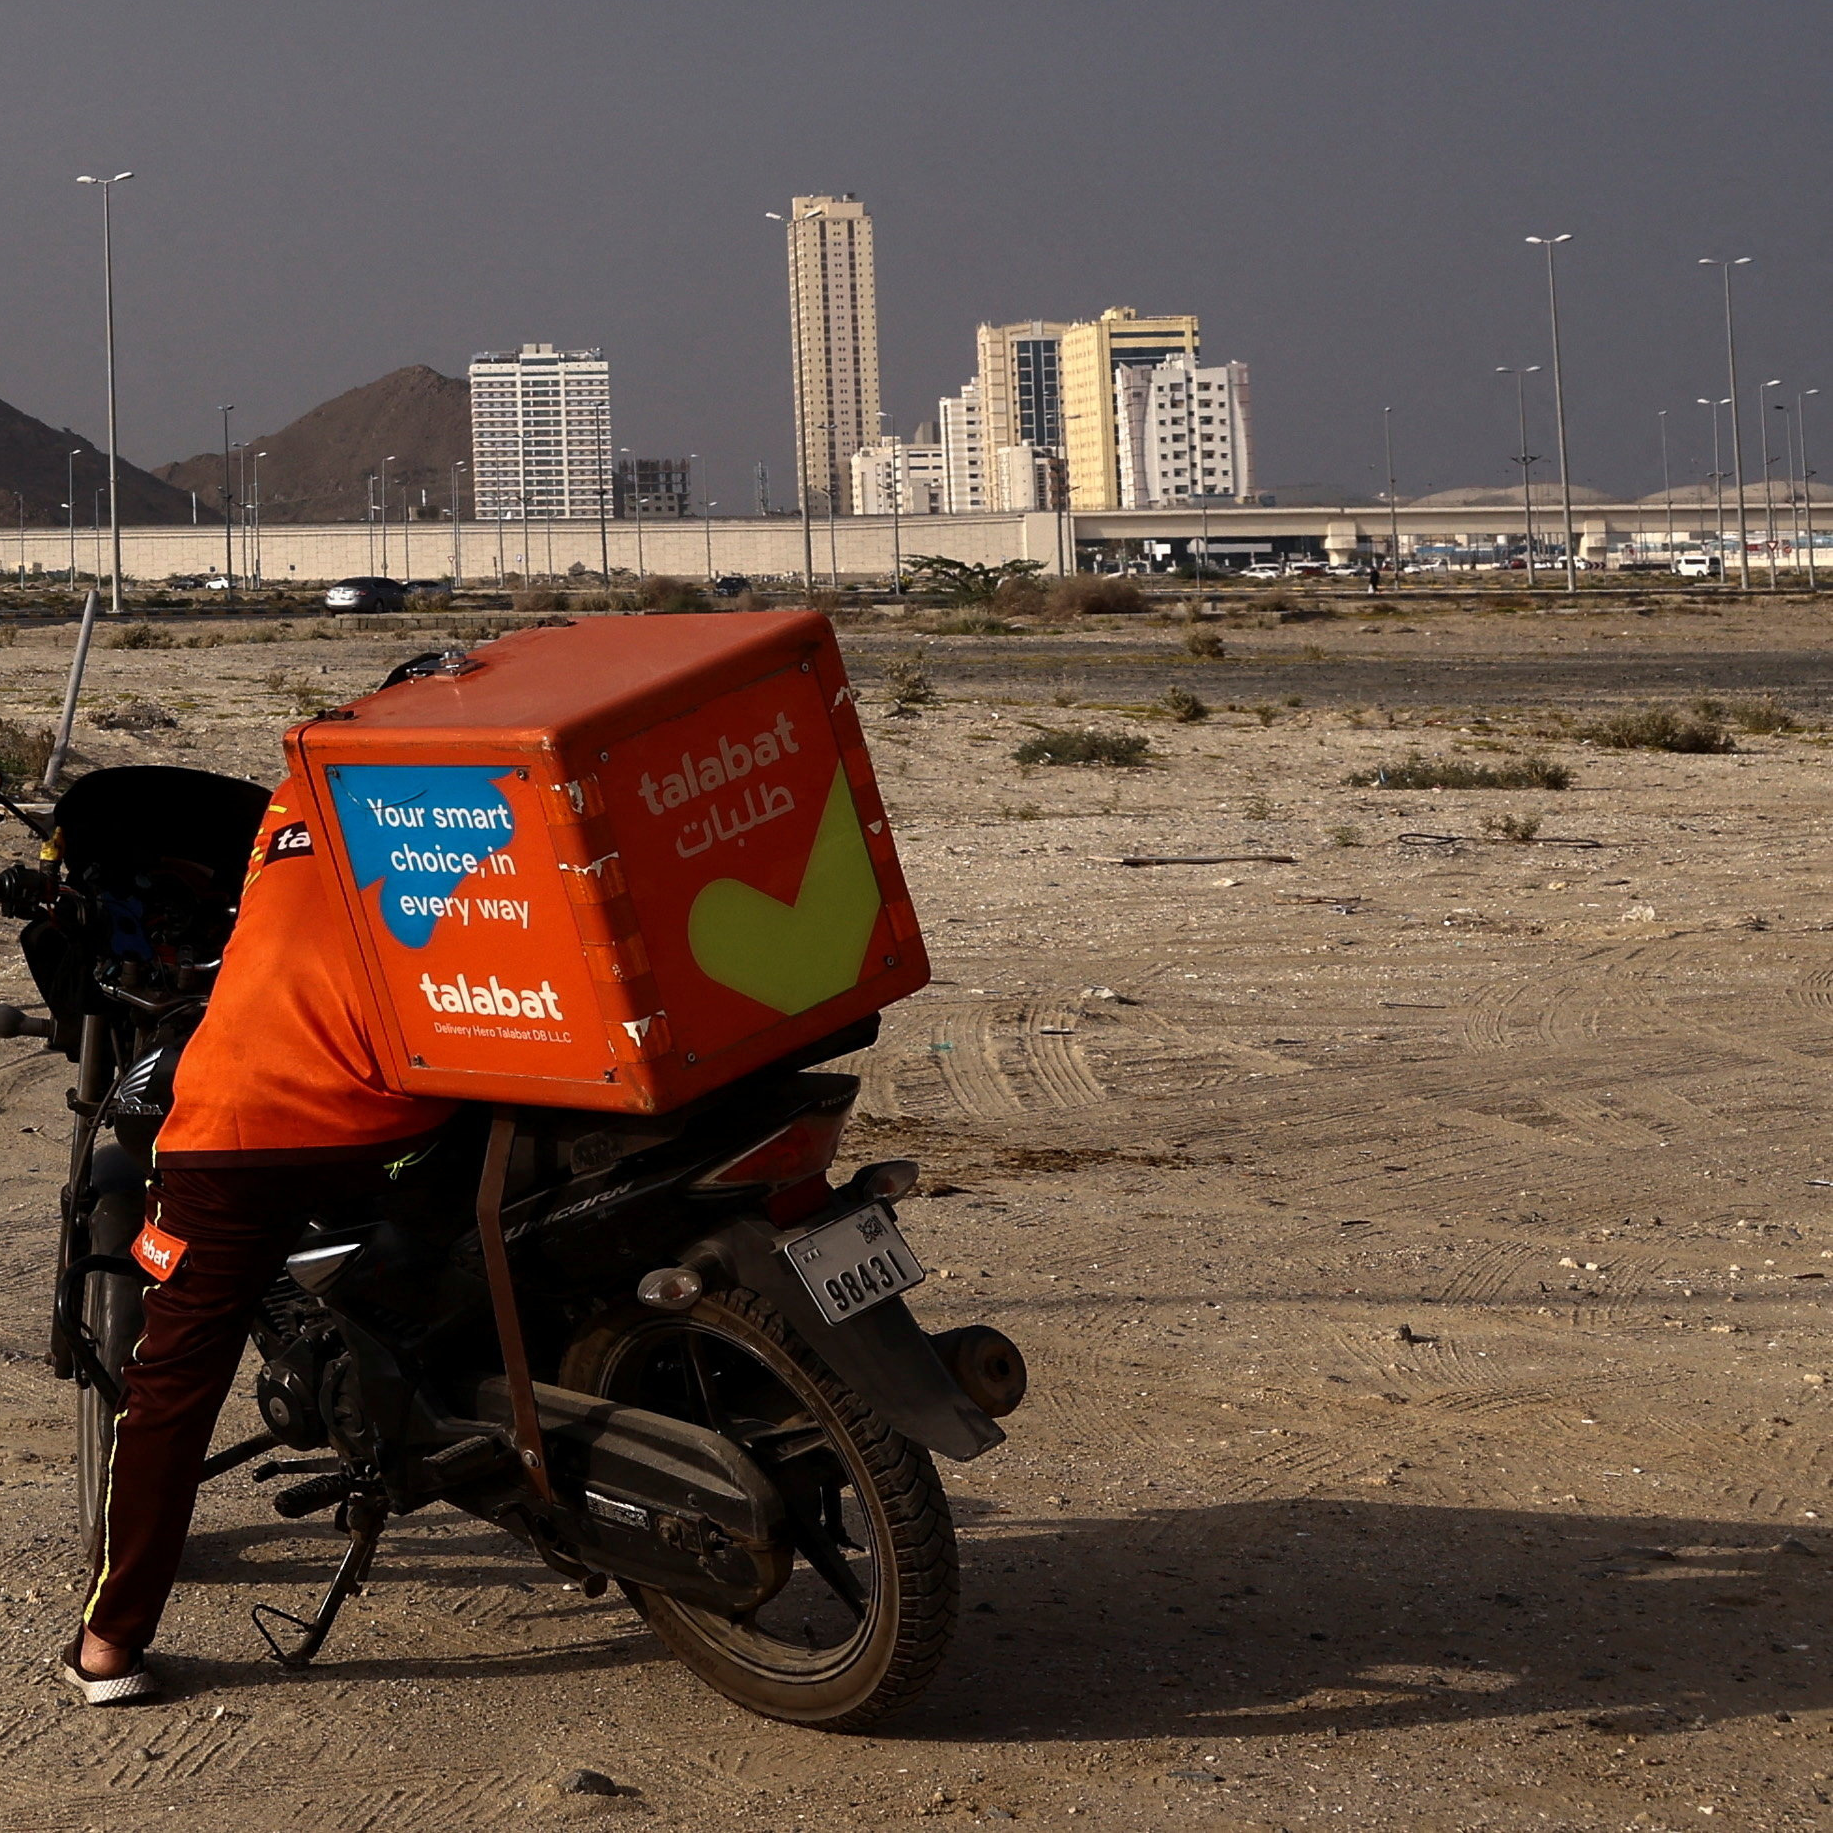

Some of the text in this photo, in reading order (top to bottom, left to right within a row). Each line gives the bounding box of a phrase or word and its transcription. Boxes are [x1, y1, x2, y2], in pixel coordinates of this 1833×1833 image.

[637, 711, 800, 815] talabat
[366, 798, 512, 829] Your smart
[675, 782, 795, 858] طلبات
[390, 843, 516, 878] choice, in
[400, 895, 529, 929] every way
[419, 972, 564, 1021] talabat
[434, 1022, 472, 1038] Delivery
[473, 1025, 496, 1037] Hero
[496, 1026, 532, 1040] Talabat
[532, 1030, 547, 1042] DB
[824, 1249, 907, 1311] 98431
